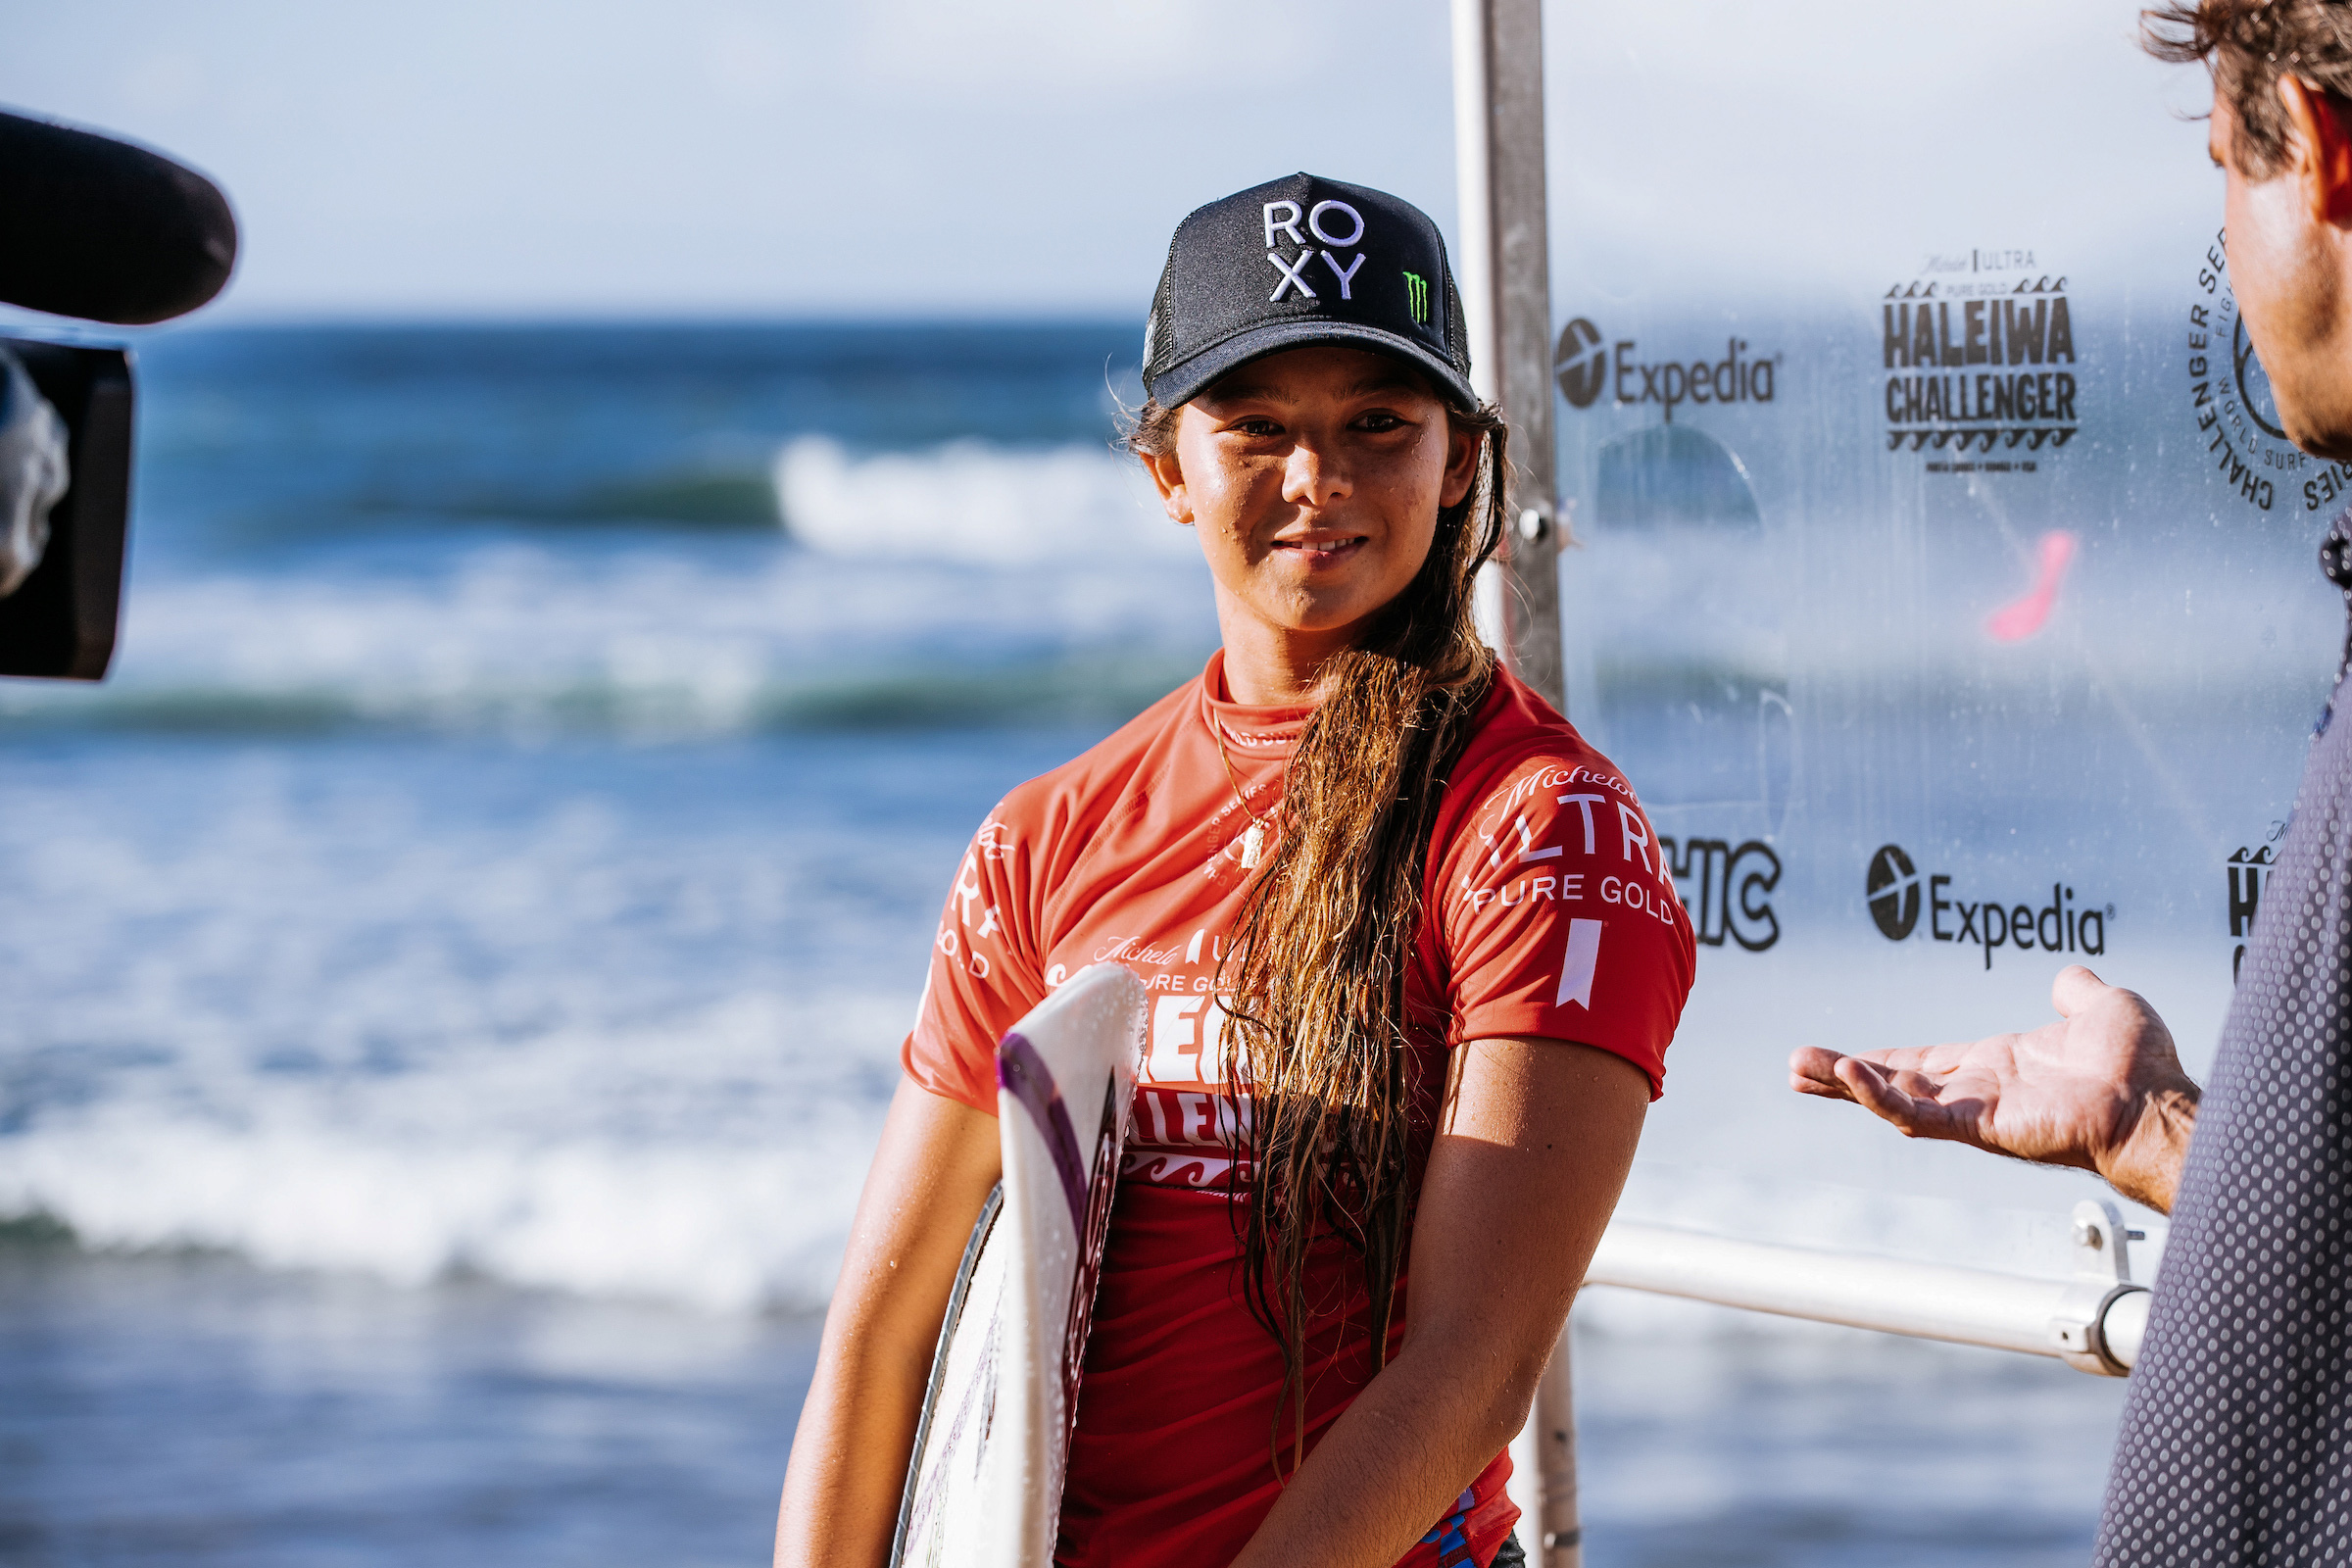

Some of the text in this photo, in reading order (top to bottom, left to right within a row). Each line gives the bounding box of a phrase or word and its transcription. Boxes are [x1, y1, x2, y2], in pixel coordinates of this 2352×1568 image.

[1263, 200, 1365, 248] RO
[1267, 249, 1366, 302] XY
[1982, 250, 2037, 270] ULTRA
[1883, 297, 2076, 368] HALEIWA
[1886, 371, 2077, 422] CHALLENGER
[2188, 304, 2273, 512] CHALLENGER
[2218, 376, 2258, 455] WORLD
[1472, 874, 1675, 926] PURE GOLD
